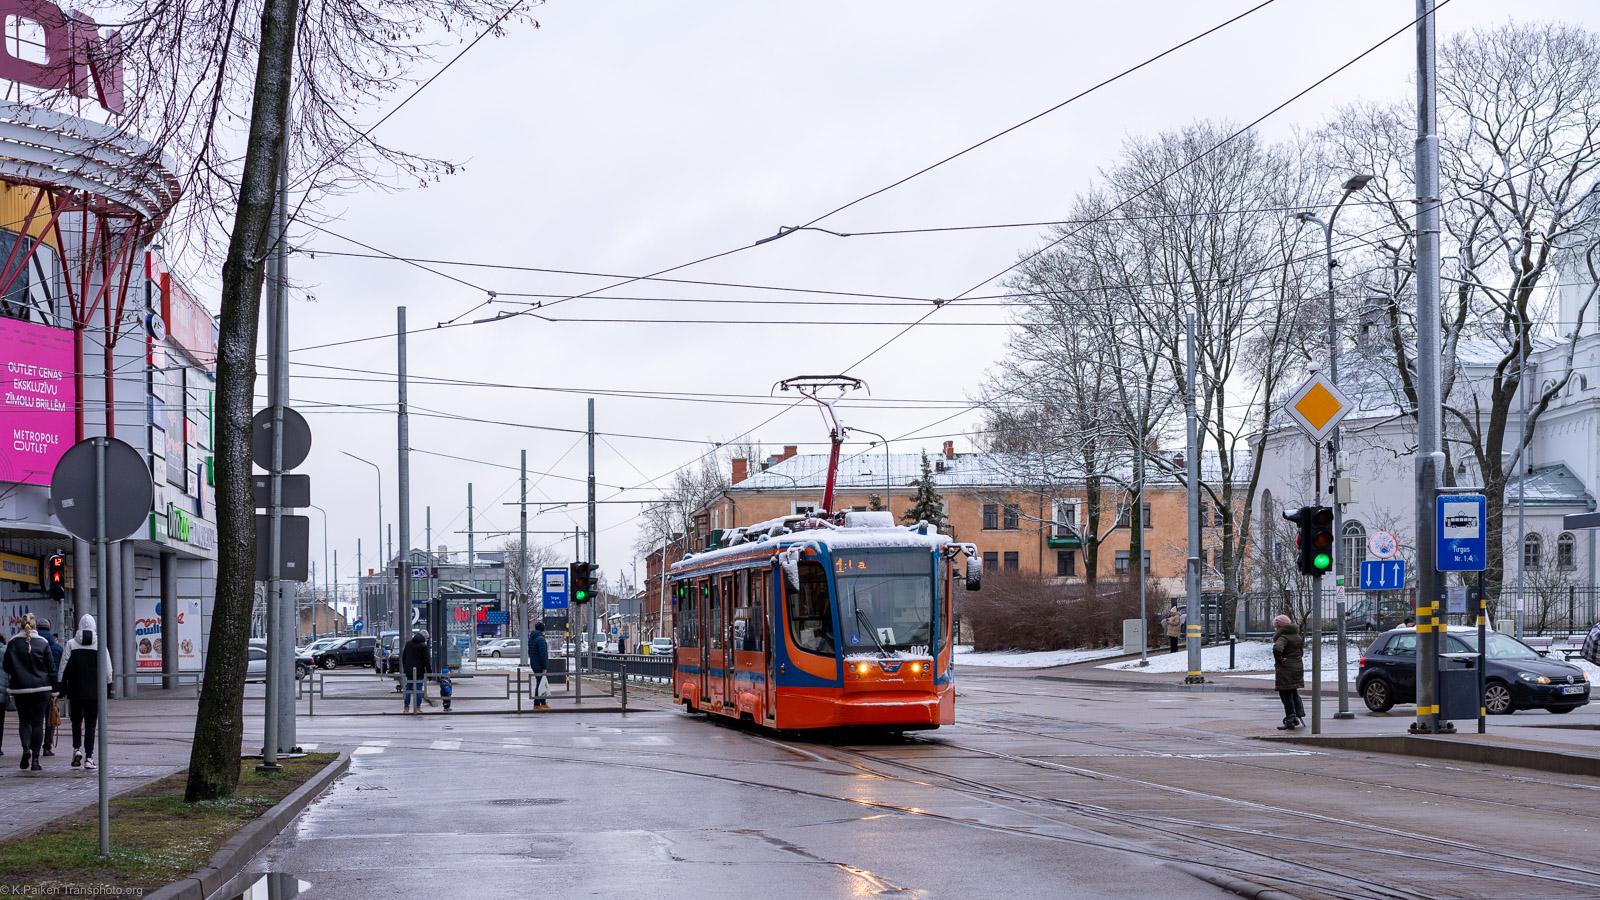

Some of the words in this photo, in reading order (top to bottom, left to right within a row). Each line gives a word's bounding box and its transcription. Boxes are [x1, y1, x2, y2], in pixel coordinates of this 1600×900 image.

[8, 361, 37, 377] OUTLET
[38, 366, 63, 381] CENAS
[13, 378, 58, 395] EKSKLUZĪVU
[5, 391, 34, 407] ZĪMOLU
[35, 398, 66, 412] BRILLĒM
[13, 428, 59, 445] METROPOLE
[13, 440, 48, 454] OUTLET
[1452, 545, 1471, 555] Tirgus
[881, 629, 891, 644] 1
[911, 645, 929, 656] 002
